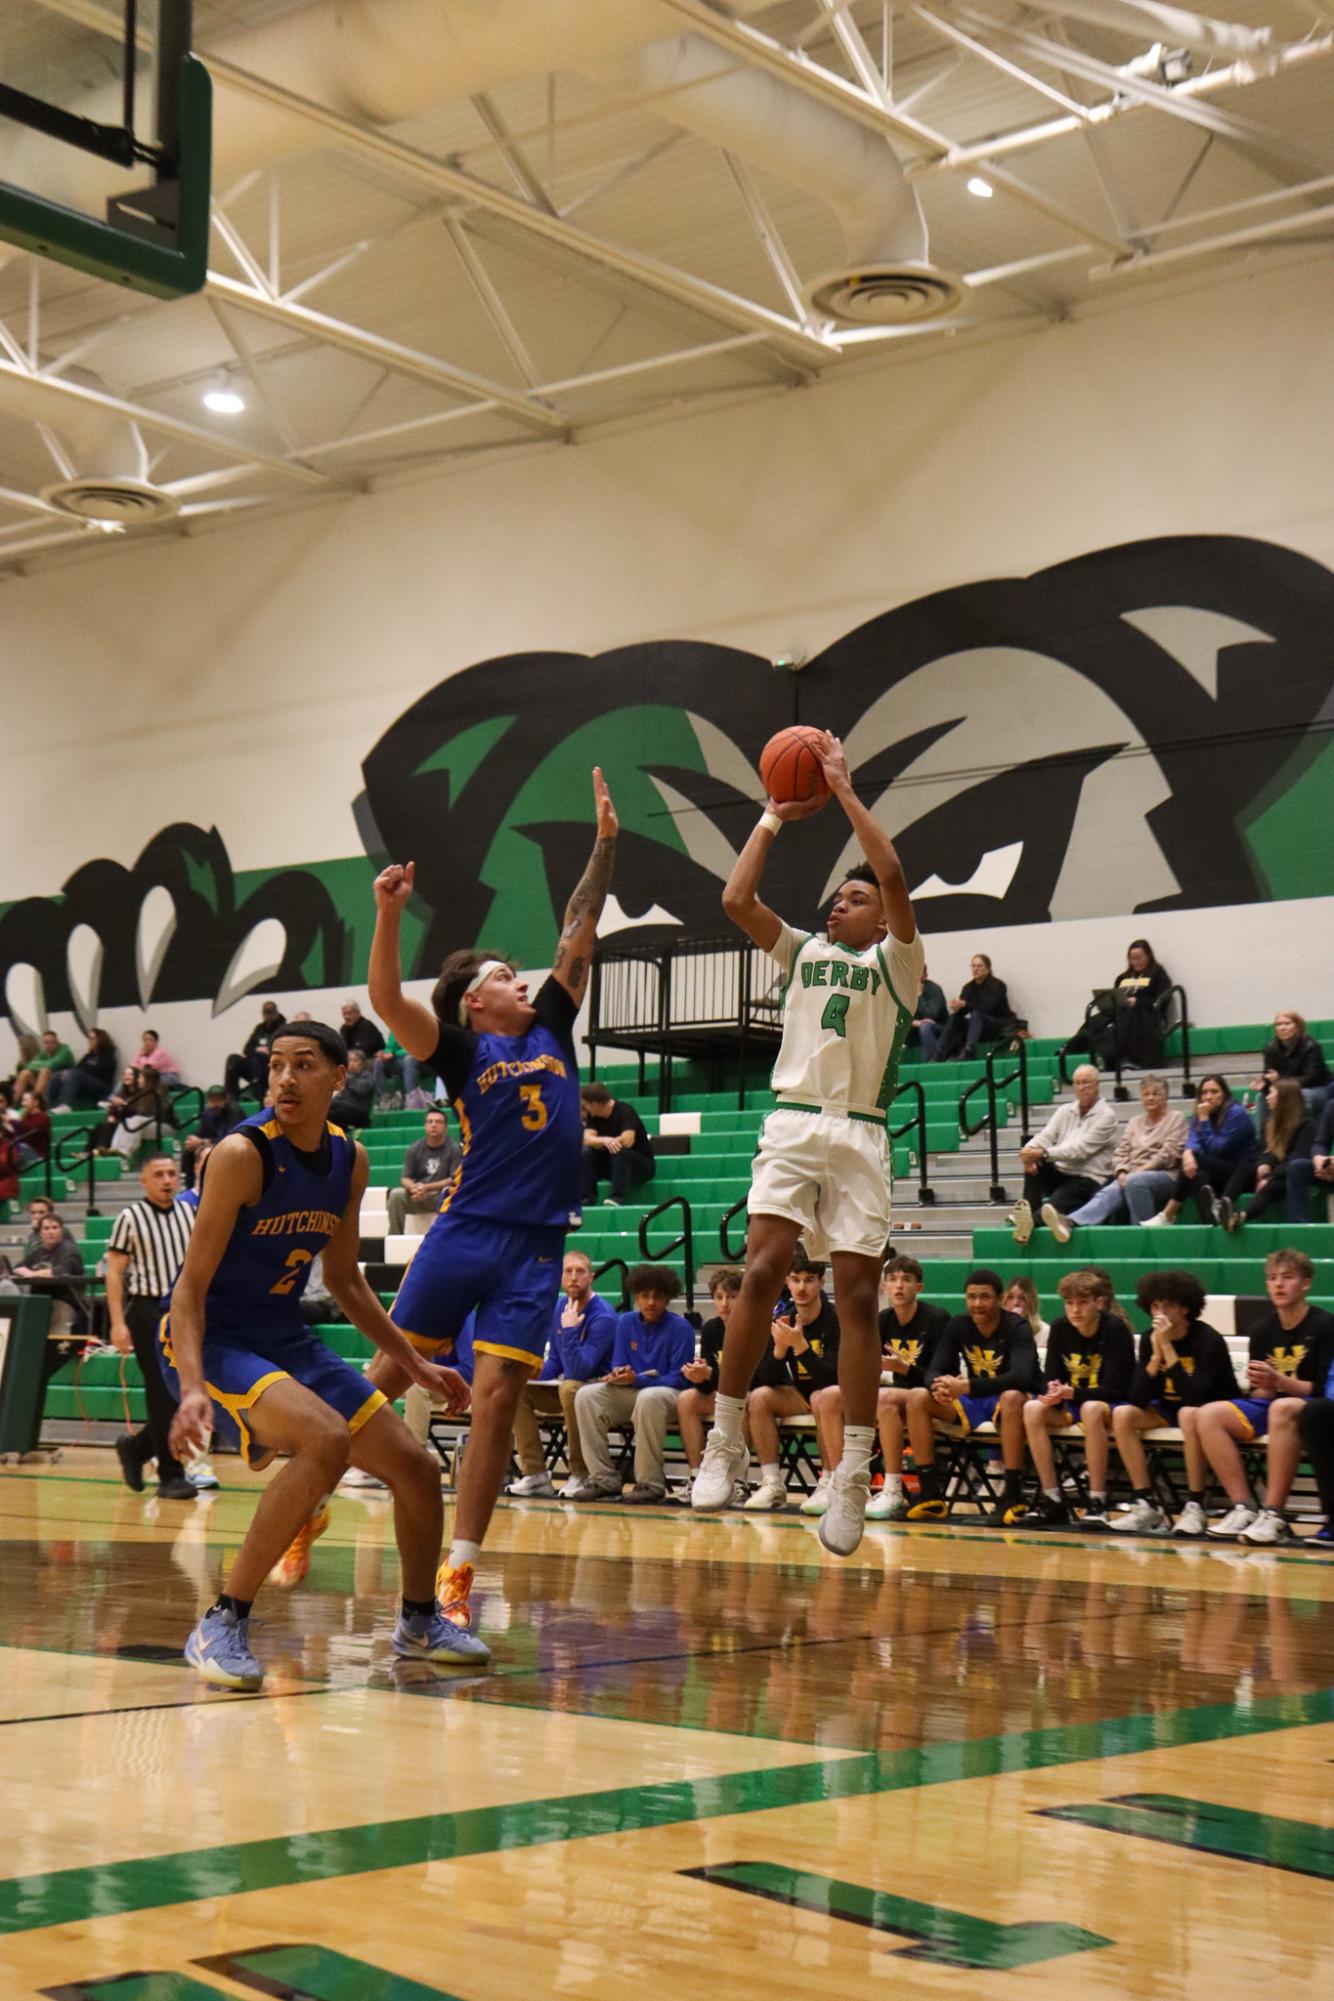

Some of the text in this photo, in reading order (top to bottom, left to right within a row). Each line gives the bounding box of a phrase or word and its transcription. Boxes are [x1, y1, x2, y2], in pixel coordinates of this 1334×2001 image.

[801, 960, 881, 996] DERBY
[821, 993, 850, 1038] 4
[520, 1084, 547, 1131] 3
[269, 1249, 312, 1295] 2
